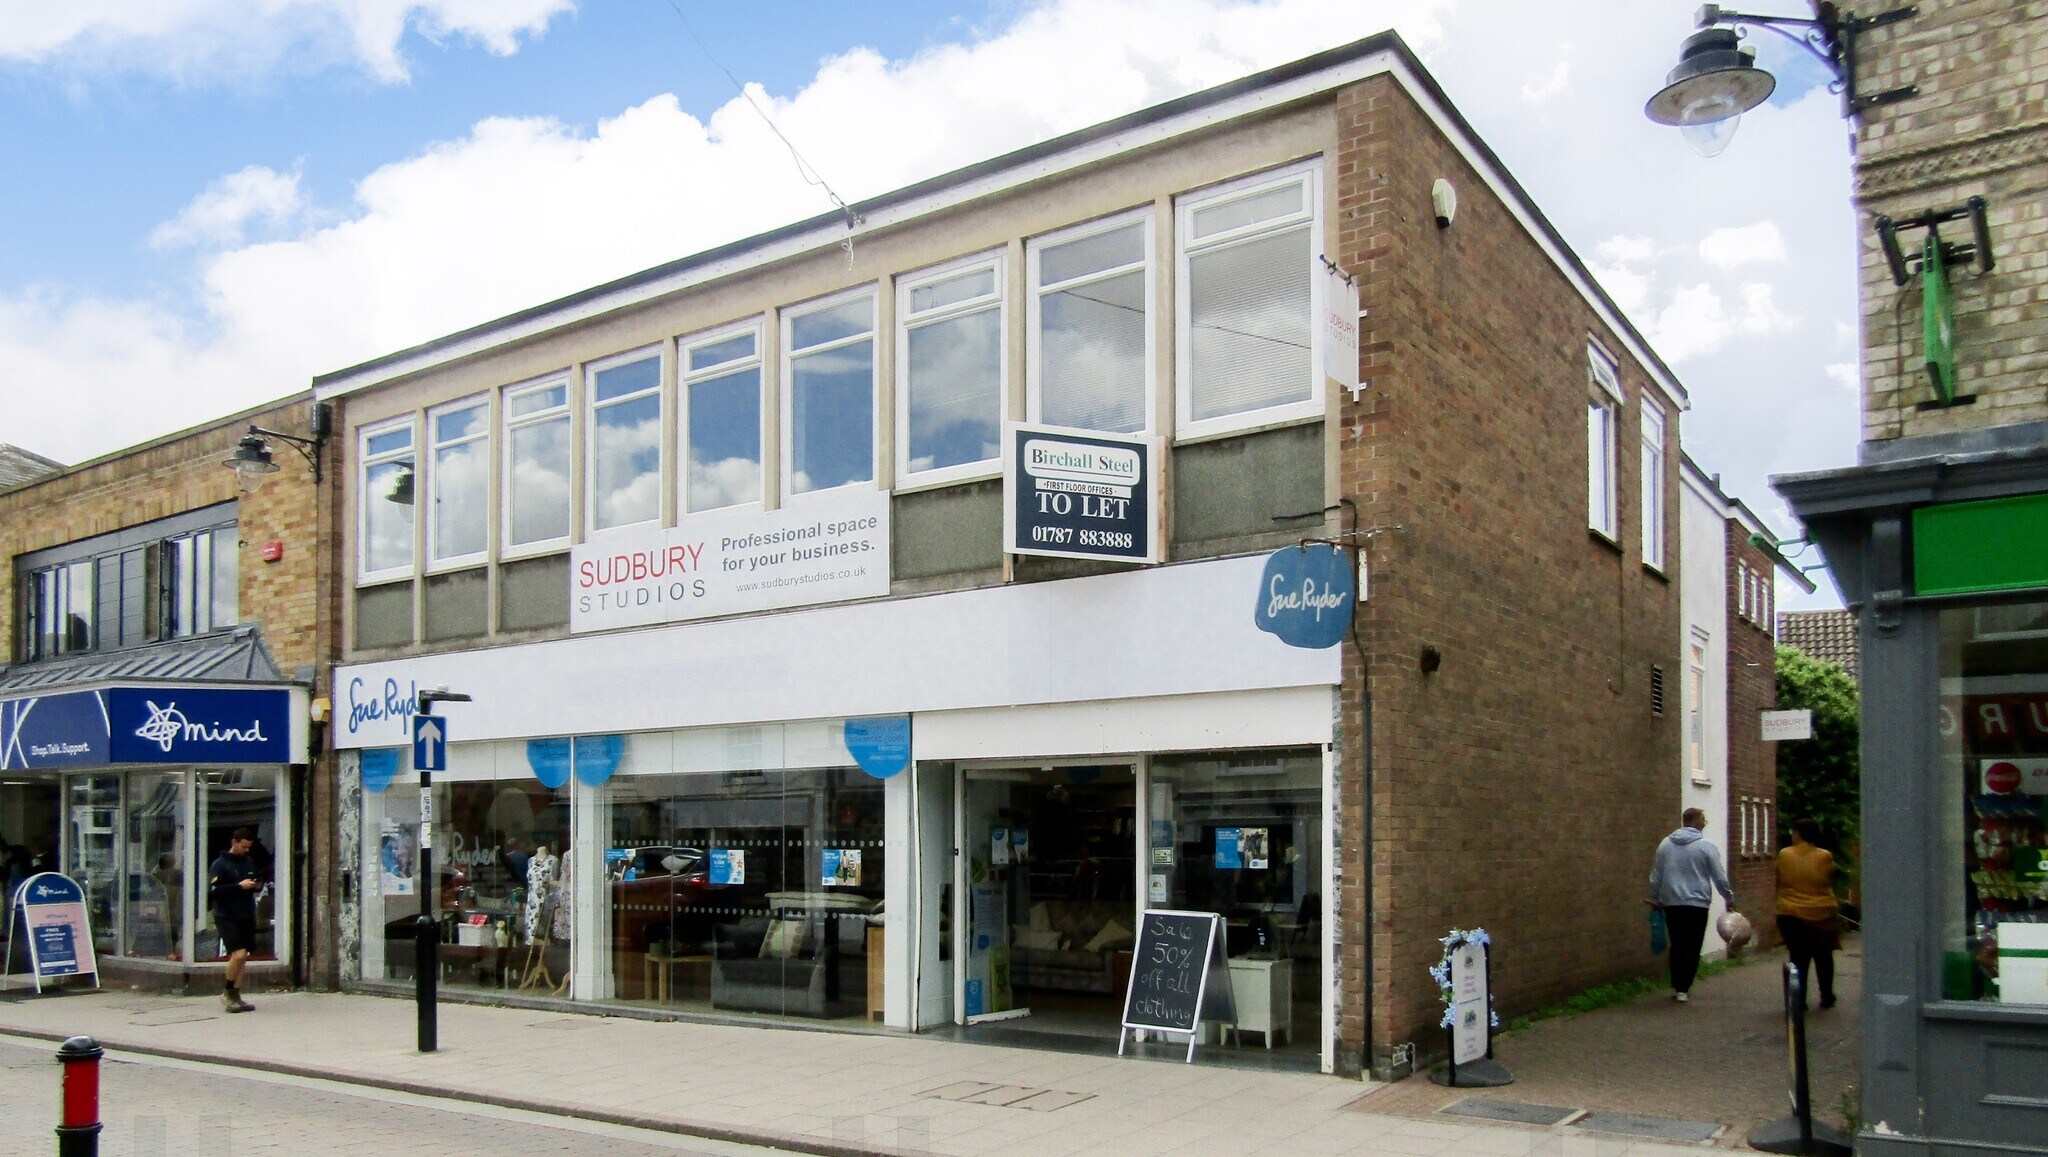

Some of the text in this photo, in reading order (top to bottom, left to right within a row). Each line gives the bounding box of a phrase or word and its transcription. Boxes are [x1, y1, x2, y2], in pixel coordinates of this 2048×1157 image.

[1324, 308, 1356, 335] SUDBURY
[1032, 448, 1134, 473] Birchall Steel
[1066, 483, 1087, 493] FLOOR
[1088, 485, 1113, 496] OFFICES
[1035, 491, 1131, 520] TO LET
[721, 515, 878, 552] Professional space
[1032, 525, 1133, 549] 01787 883888
[579, 541, 705, 589] SUDBURY
[722, 538, 876, 573] for your business.
[736, 565, 867, 593] www.sudburystudios.co.uk
[579, 578, 706, 613] STUDIOS
[1268, 573, 1347, 622] Sue Ryder
[349, 677, 421, 735] Sue Ryd
[184, 719, 268, 742] mind
[452, 831, 501, 882] Ryder
[1152, 942, 1194, 969] 50%
[1141, 968, 1190, 994] off all
